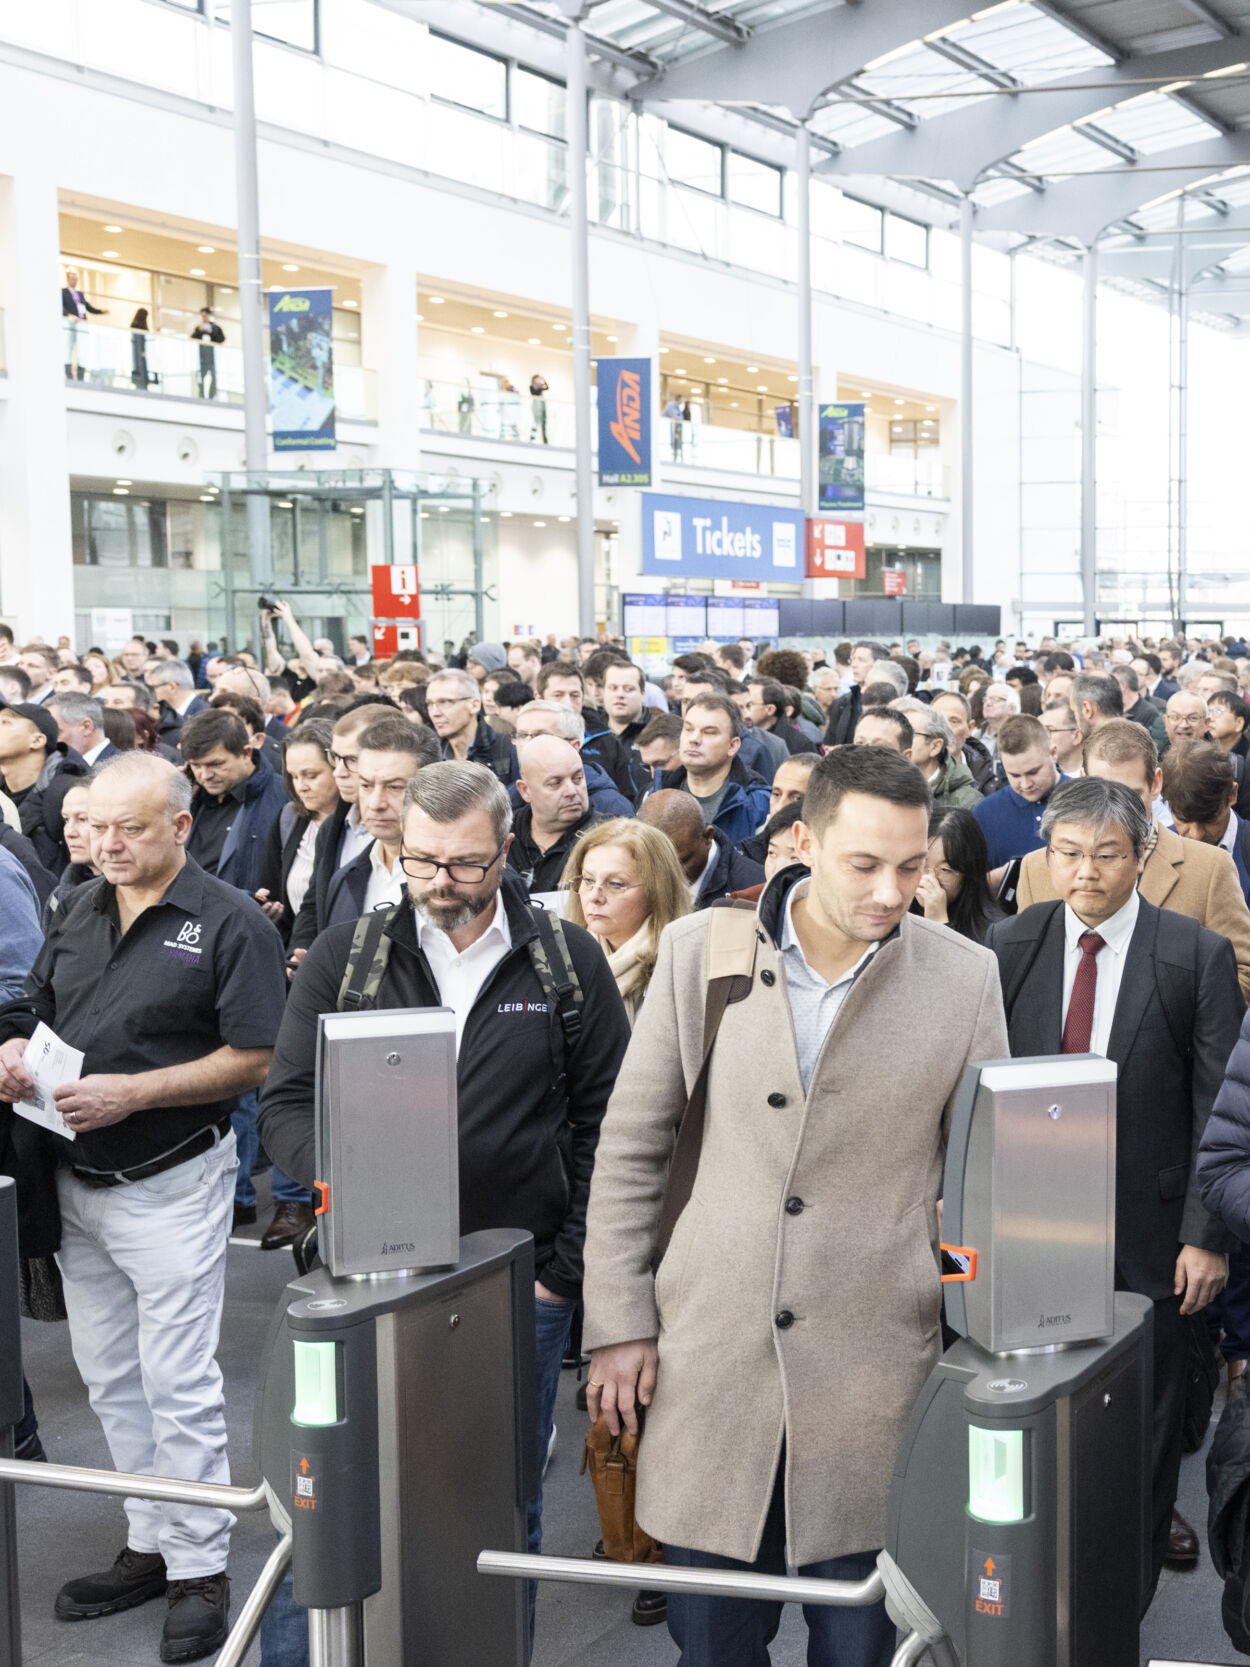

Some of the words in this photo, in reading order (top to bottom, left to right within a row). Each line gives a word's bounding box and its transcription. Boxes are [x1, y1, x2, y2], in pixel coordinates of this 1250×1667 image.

[609, 369, 641, 465] ANDA
[602, 472, 619, 484] Hall
[692, 516, 762, 558] Tickets
[497, 1000, 549, 1014] LEIBINGE
[389, 1242, 416, 1252] ADITUS
[294, 1496, 318, 1511] EXIT
[975, 1600, 1005, 1616] EXIT
